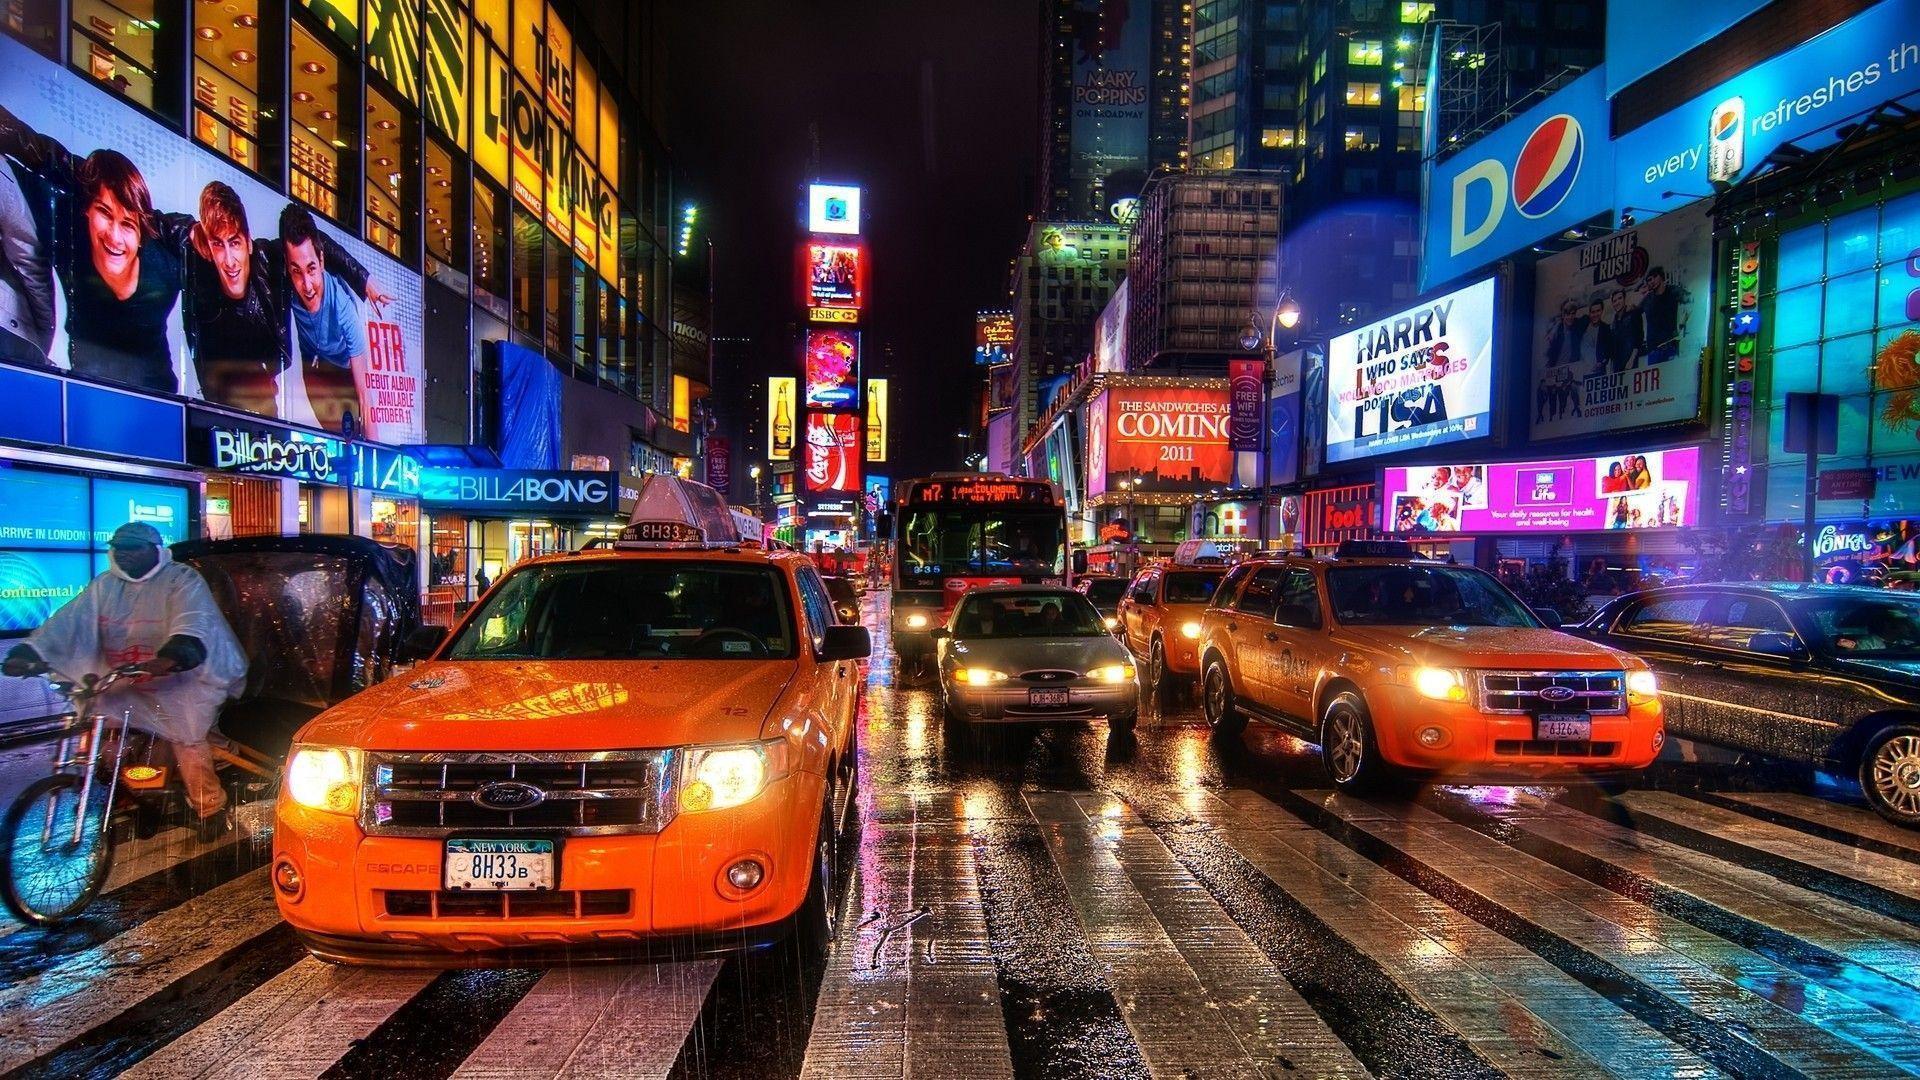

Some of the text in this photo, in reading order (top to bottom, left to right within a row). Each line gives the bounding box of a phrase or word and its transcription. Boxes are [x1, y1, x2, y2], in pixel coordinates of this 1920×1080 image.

[531, 22, 572, 112] THE
[1087, 70, 1138, 88] MARY
[484, 20, 554, 179] LION
[1076, 86, 1146, 106] POPPINS
[1077, 109, 1144, 119] ON BROADWAY
[1643, 144, 1702, 185] every
[1750, 62, 1880, 137] refreshes
[558, 116, 612, 241] KING
[1582, 231, 1637, 268] BIG TIME
[1600, 253, 1632, 281] RUSH
[810, 310, 840, 319] HSBC
[1356, 299, 1454, 364] HARRY
[367, 321, 406, 372] BTR
[1366, 360, 1396, 381] WHO
[365, 373, 416, 392] DEBUT ALBUM
[1586, 372, 1625, 393] DEBUT
[1633, 368, 1660, 394] BTR
[378, 391, 414, 407] AVAILABLE
[1235, 391, 1258, 401] FREE
[1585, 385, 1628, 406] ALBUM
[370, 407, 412, 424] OCTOBER 11
[1119, 401, 1142, 412] THE
[1144, 401, 1217, 413] SANDWICHES
[1237, 402, 1256, 411] WIFI
[1354, 385, 1448, 439] LISA
[1584, 401, 1633, 418] OCTOBER 11
[1160, 446, 1194, 461] 2011
[461, 476, 608, 502] BILLABONG
[923, 484, 942, 501] M7
[975, 484, 1017, 494] COLUMBUS
[1325, 502, 1363, 529] Foot
[1491, 510, 1508, 519] Your
[1509, 510, 1527, 519] daily
[1560, 509, 1572, 517] for
[1573, 508, 1594, 516] health
[0, 527, 33, 539] ARRIVE
[35, 528, 46, 540] IN
[48, 529, 85, 541] LONDON
[642, 524, 679, 539] 8H33
[0, 585, 73, 599] ontinental
[473, 842, 528, 852] NEW YORK
[366, 862, 441, 875] ESCAPE
